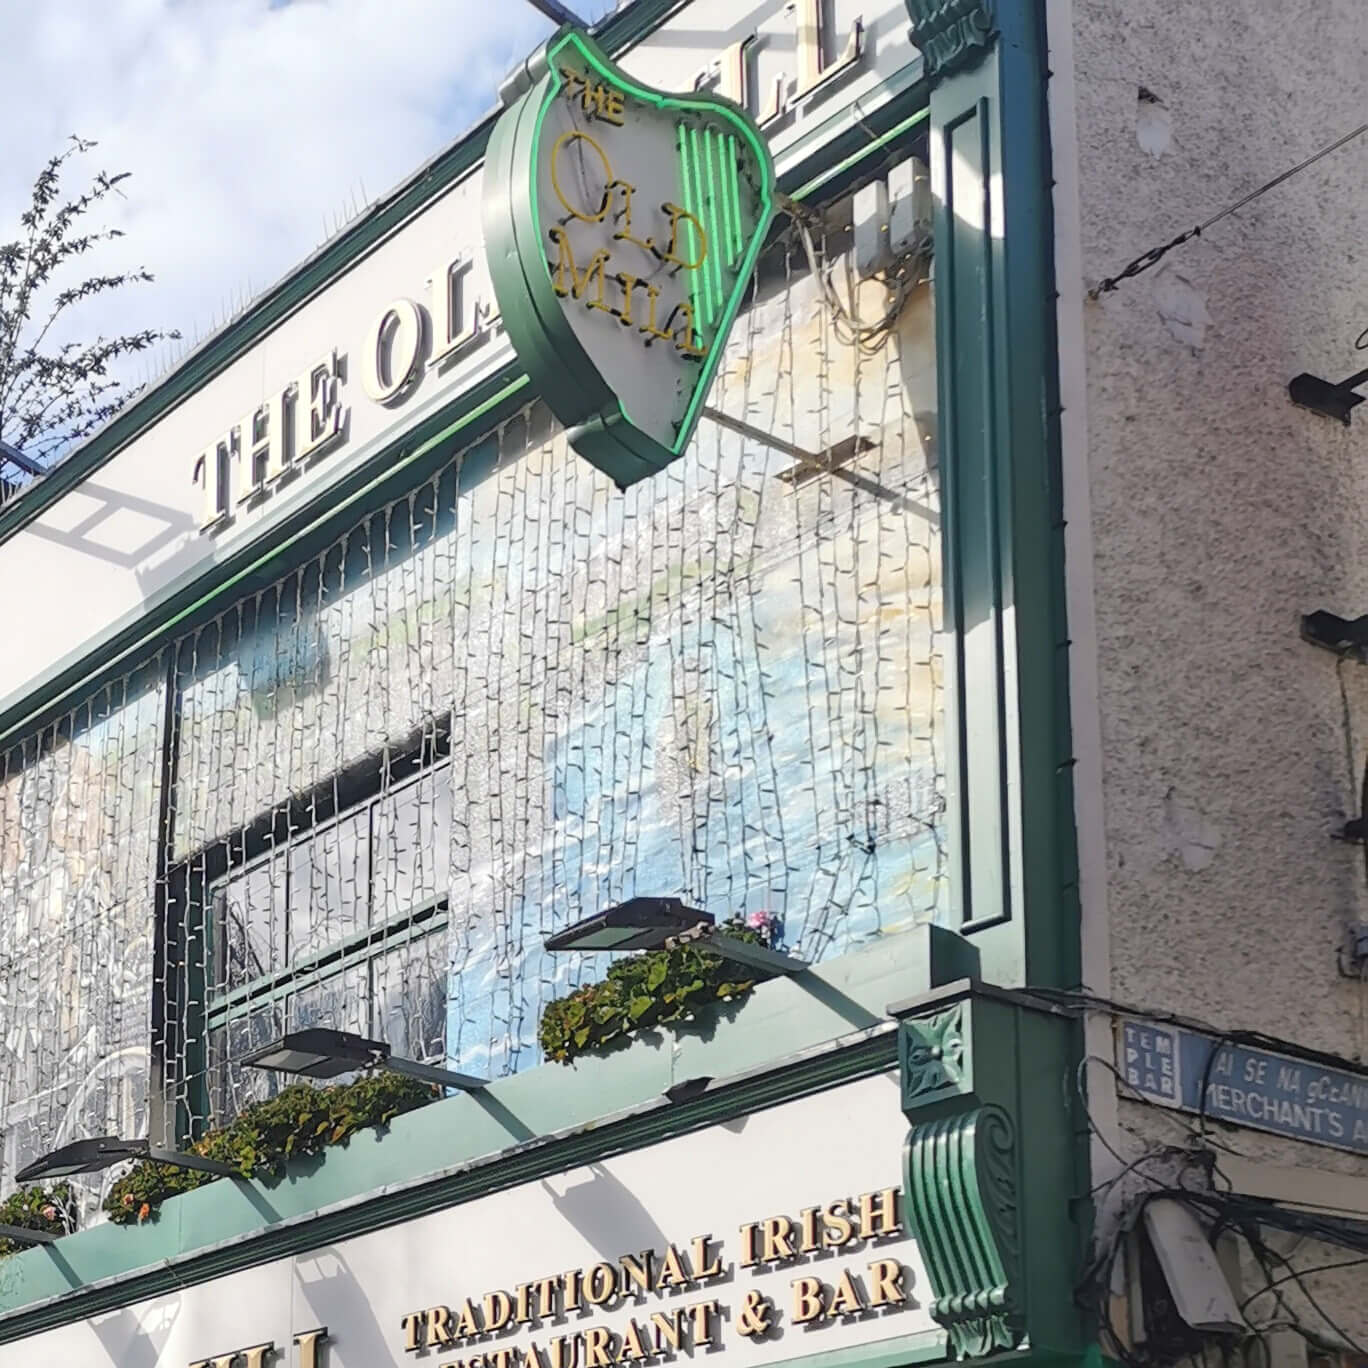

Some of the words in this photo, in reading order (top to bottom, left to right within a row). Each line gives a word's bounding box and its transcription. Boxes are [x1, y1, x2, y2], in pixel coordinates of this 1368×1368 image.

[559, 68, 626, 127] THE
[550, 130, 708, 270] OLD
[550, 227, 707, 360] MILL
[192, 345, 347, 533] THE
[363, 258, 504, 402] OL
[401, 1233, 723, 1354] TRADITIONAL
[738, 1186, 903, 1268] IRISH
[735, 1290, 772, 1337] &
[790, 1257, 908, 1327] BAR
